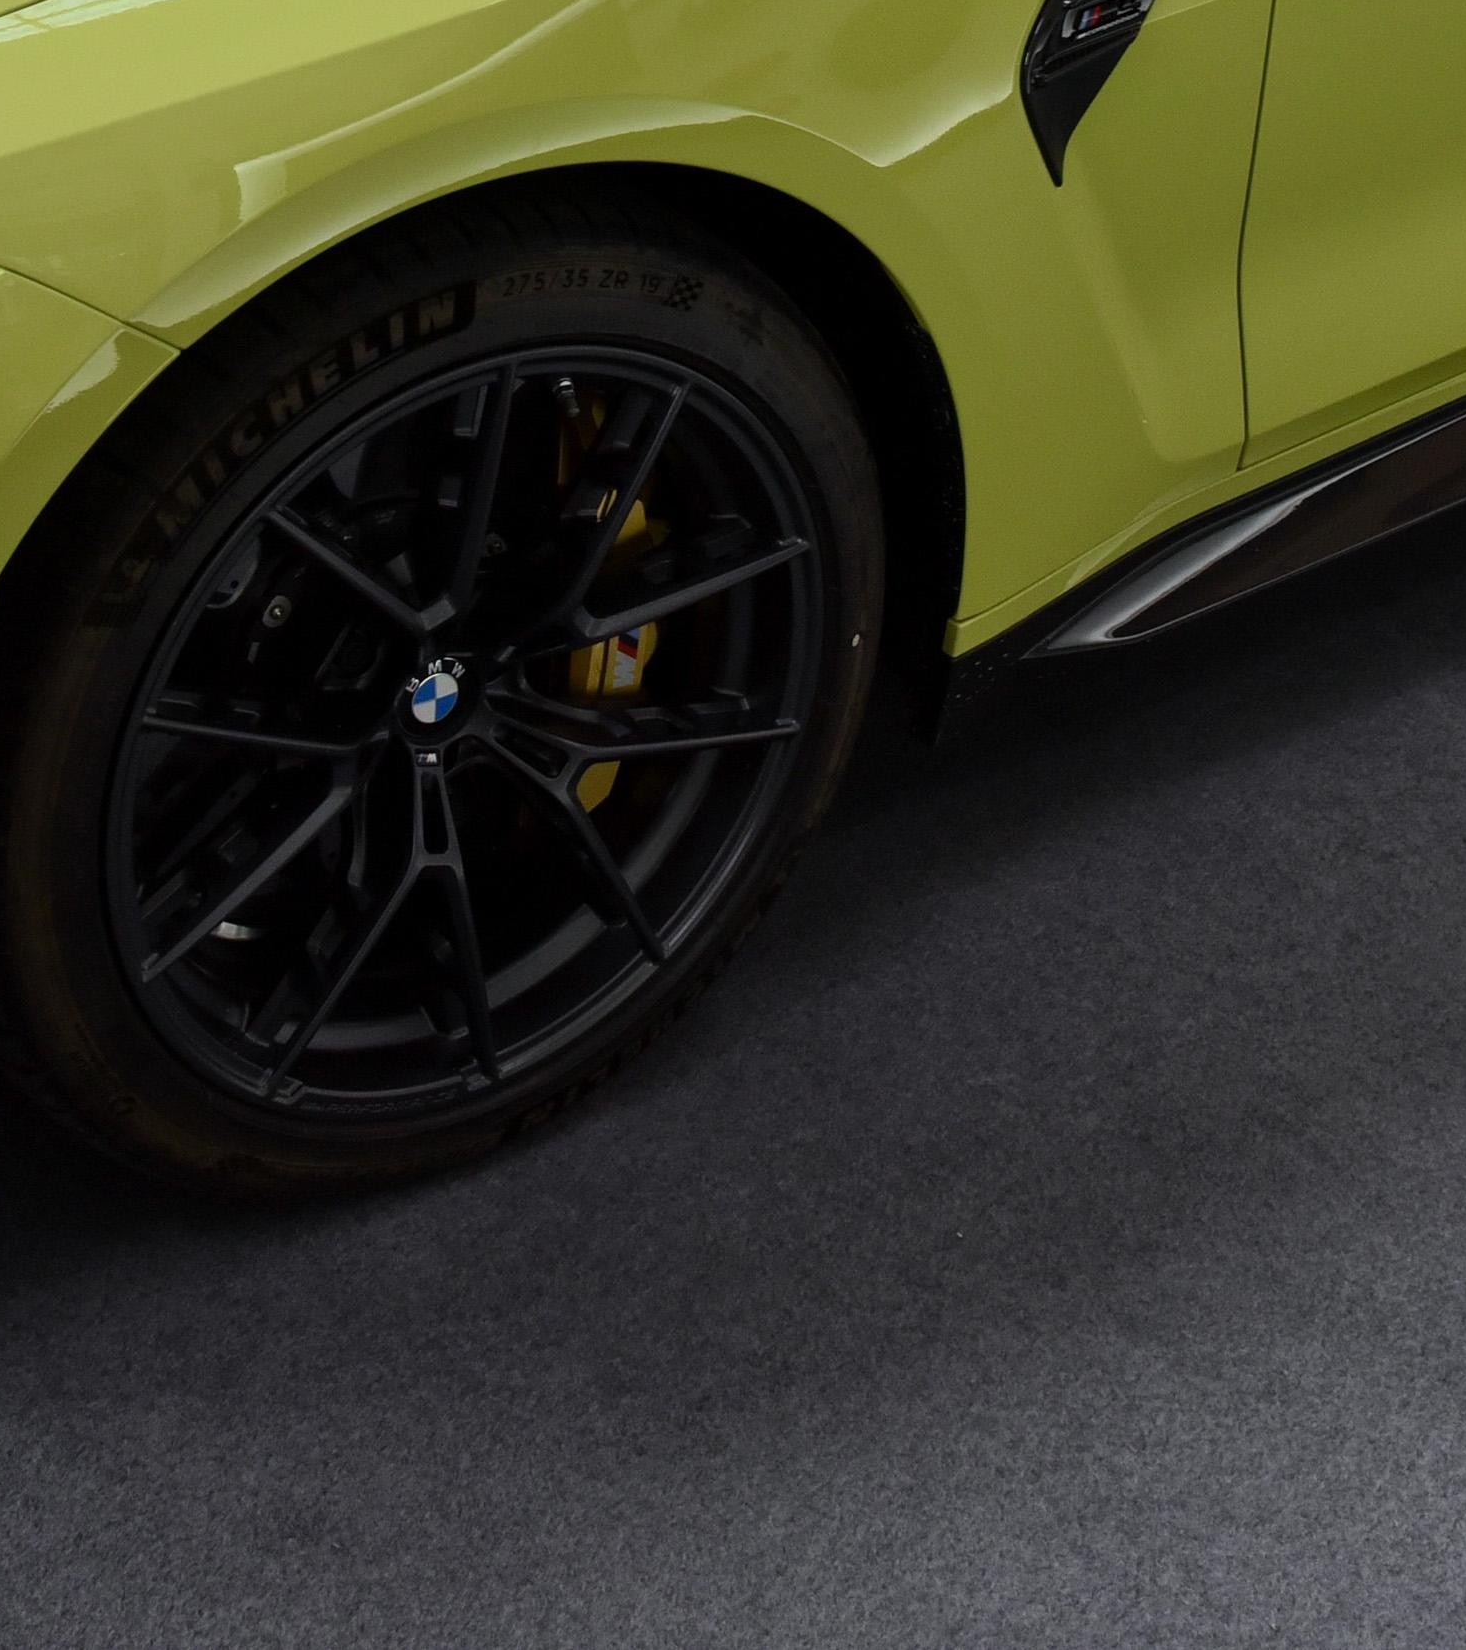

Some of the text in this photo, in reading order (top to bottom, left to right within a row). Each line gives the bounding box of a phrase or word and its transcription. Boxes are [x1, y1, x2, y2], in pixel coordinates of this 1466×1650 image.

[503, 269, 661, 297] 275/35 ZR 19
[156, 290, 456, 541] MICHELIN
